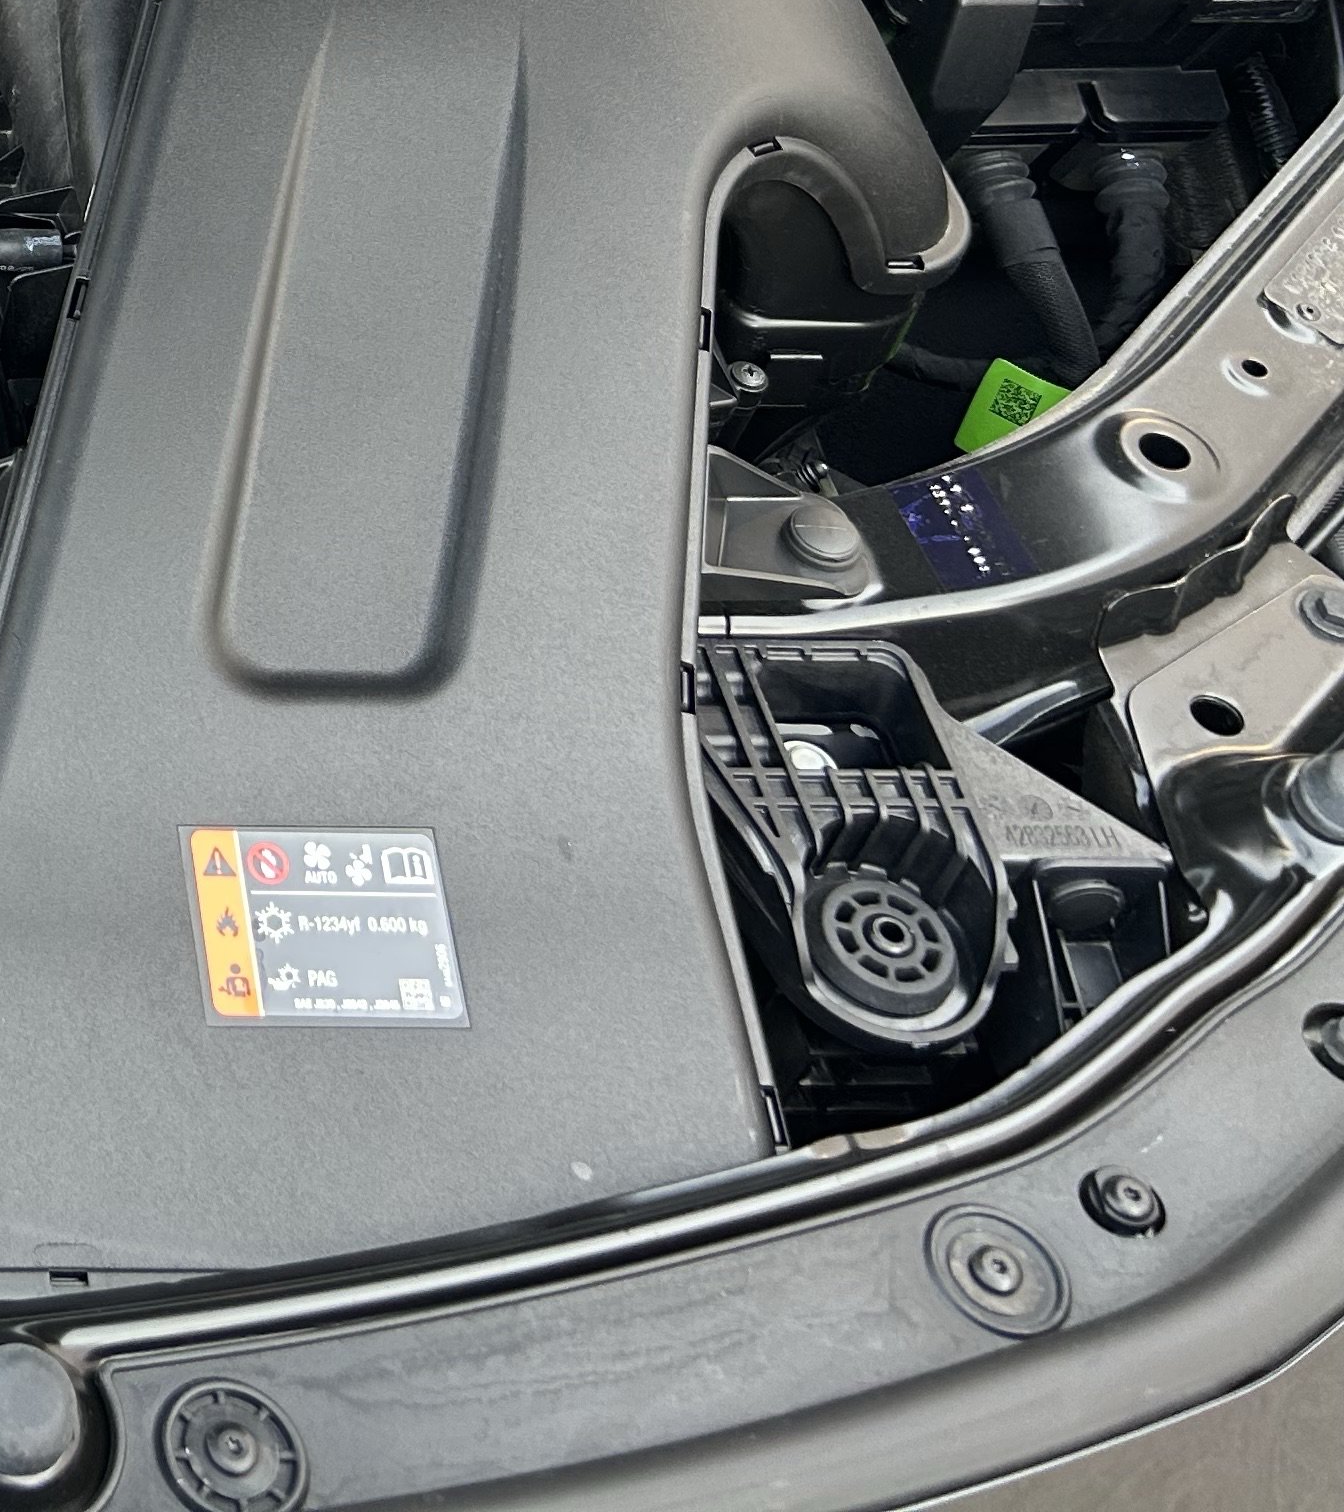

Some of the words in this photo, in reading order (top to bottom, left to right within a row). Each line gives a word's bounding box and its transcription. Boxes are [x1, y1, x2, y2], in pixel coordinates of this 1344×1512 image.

[304, 870, 338, 885] AUTO
[297, 915, 361, 936] R-1234yf
[367, 917, 407, 933] 0.600
[408, 916, 429, 937] kg
[307, 969, 338, 987] PAG
